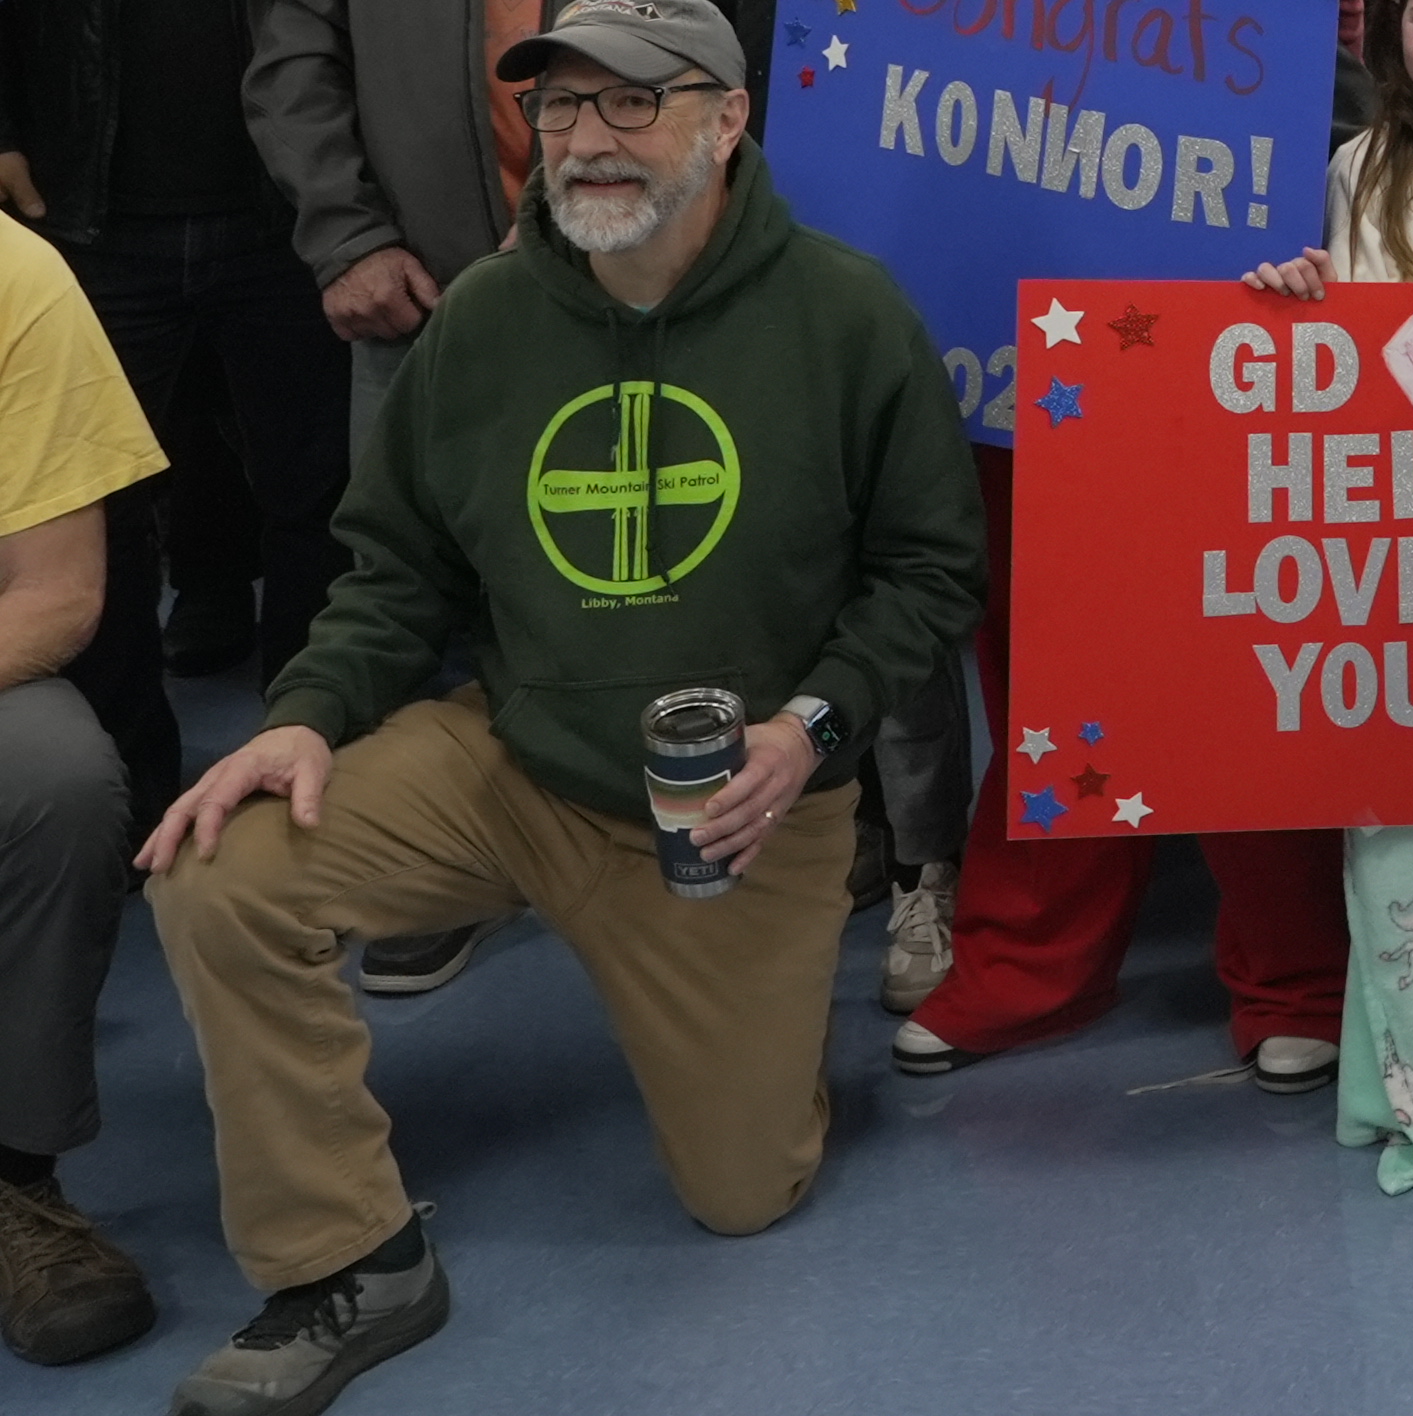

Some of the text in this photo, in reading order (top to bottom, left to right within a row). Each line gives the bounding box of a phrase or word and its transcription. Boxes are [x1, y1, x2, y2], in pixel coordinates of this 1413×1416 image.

[1209, 322, 1359, 413] GD
[943, 345, 1016, 431] 02
[543, 483, 581, 496] Turner
[657, 477, 675, 491] Ski
[680, 473, 720, 488] Patrol
[581, 593, 680, 610] Libby, Montana
[678, 865, 715, 876] YETI
